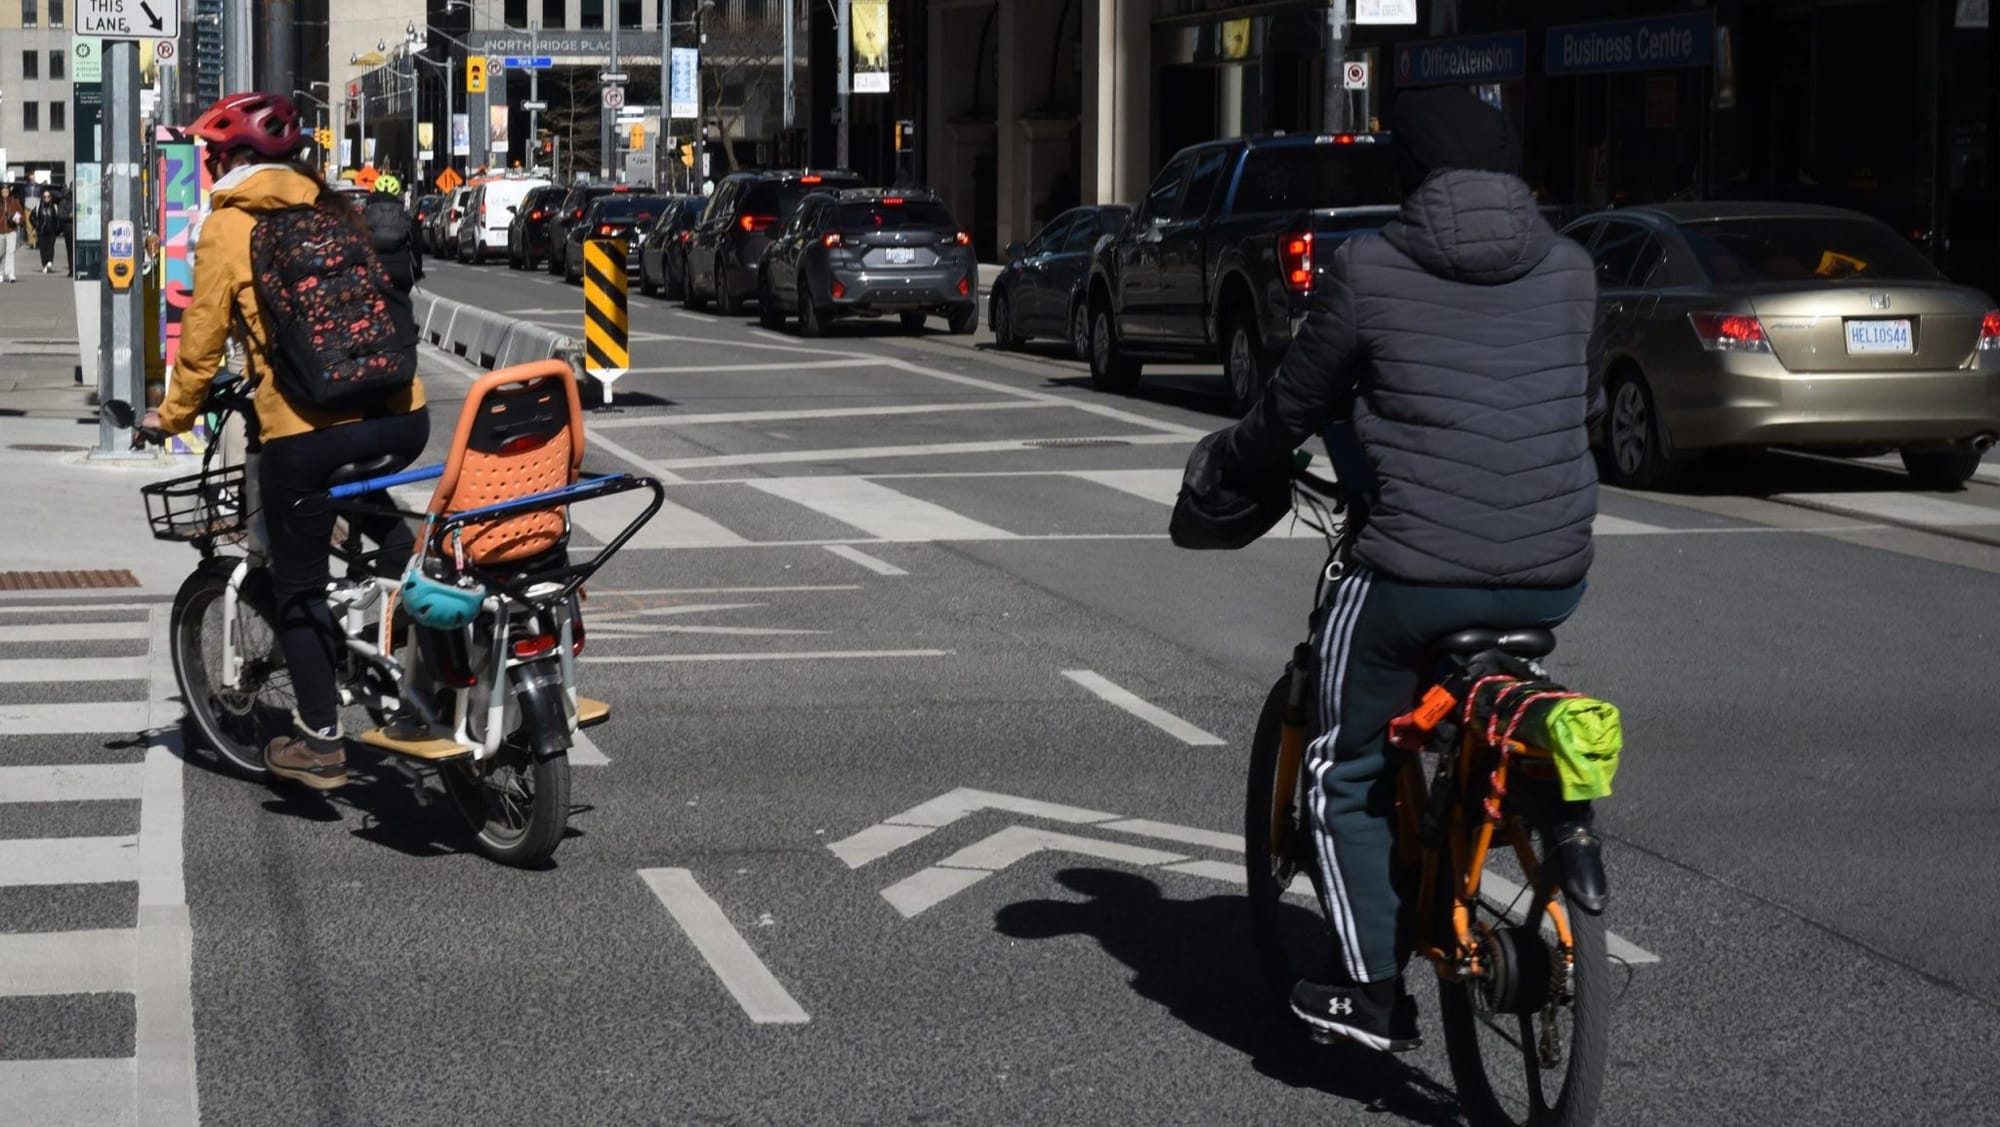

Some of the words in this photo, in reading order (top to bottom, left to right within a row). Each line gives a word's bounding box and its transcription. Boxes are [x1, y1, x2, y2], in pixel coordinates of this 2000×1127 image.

[90, 0, 123, 13] THIS
[86, 17, 126, 31] LANE
[1563, 32, 1632, 66] Business
[1637, 26, 1693, 60] Centre
[1421, 42, 1513, 78] OfficeXtension
[1852, 327, 1907, 346] HELIOS44
